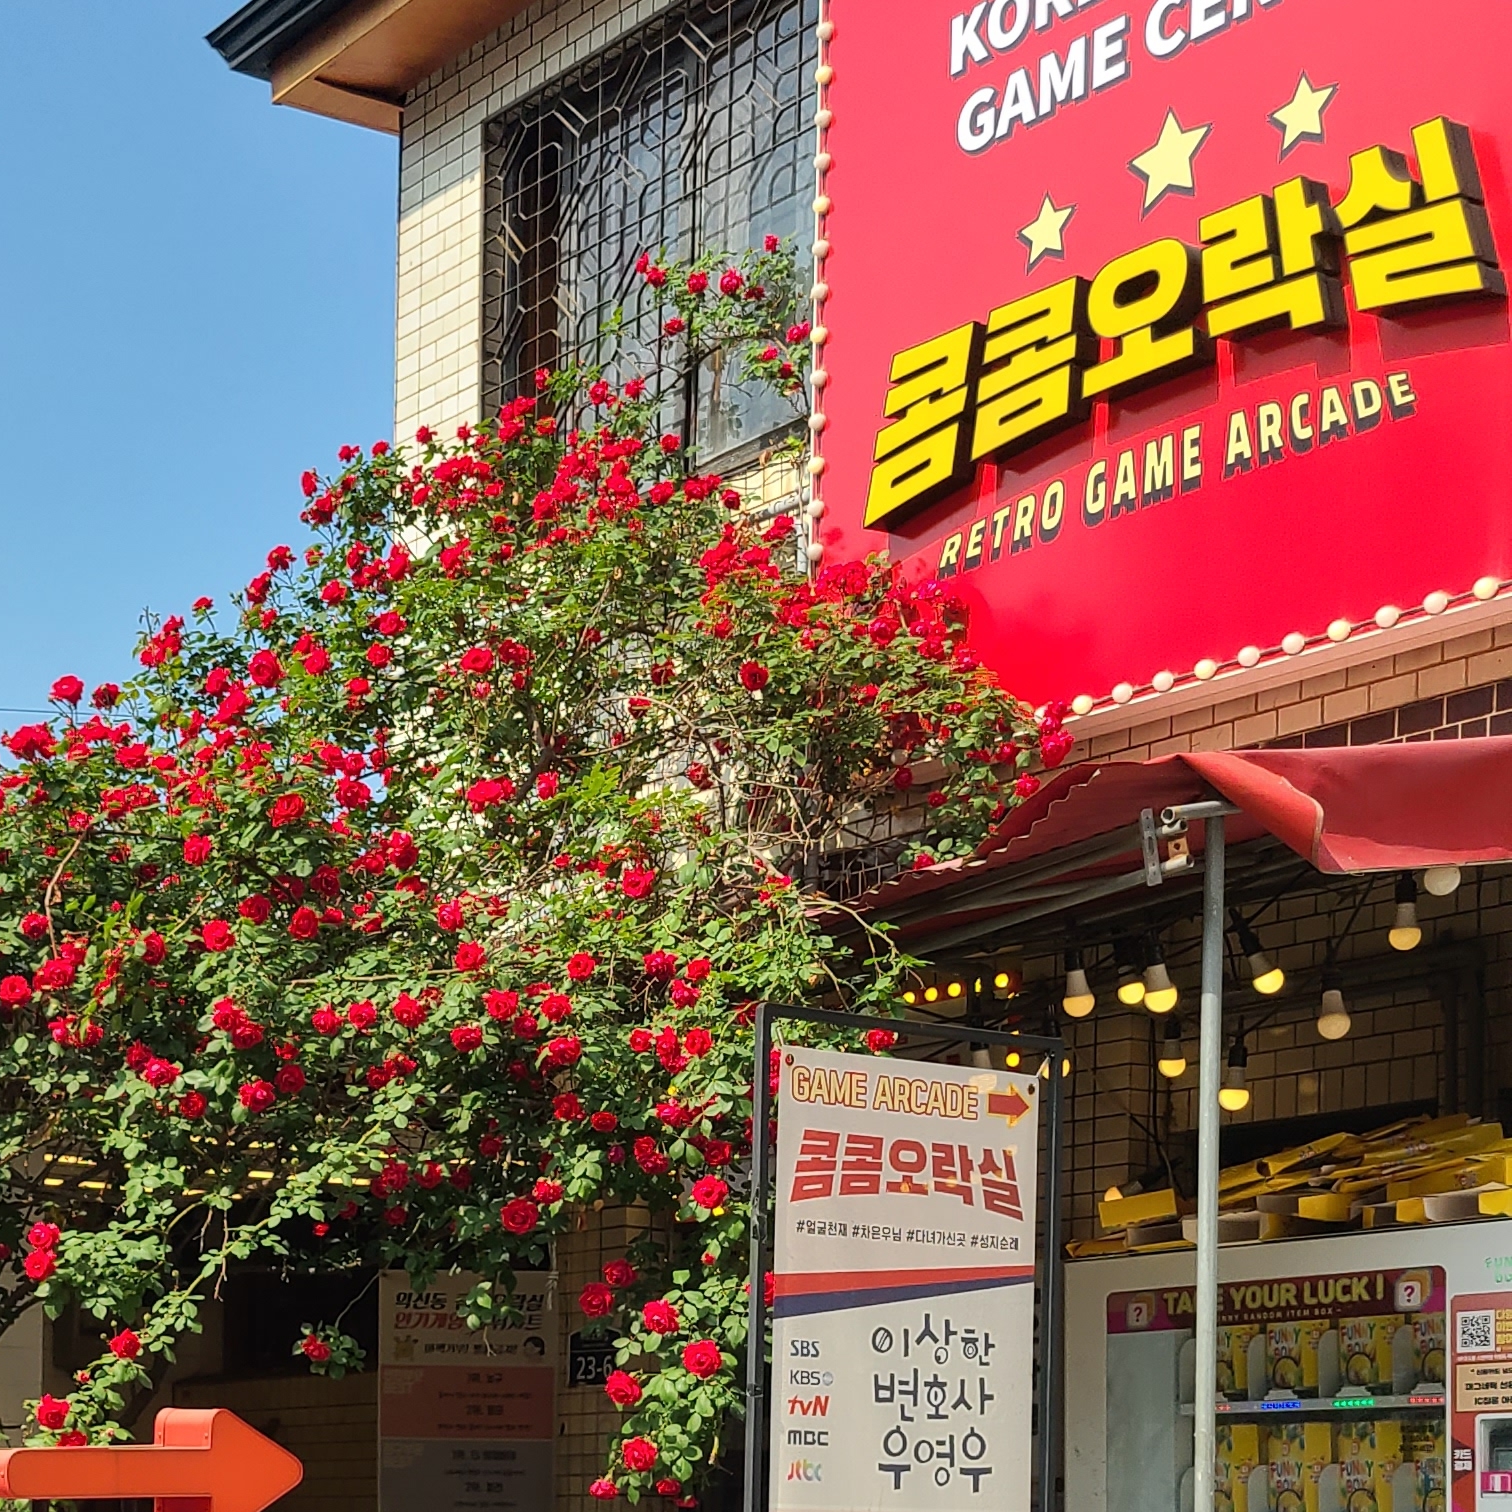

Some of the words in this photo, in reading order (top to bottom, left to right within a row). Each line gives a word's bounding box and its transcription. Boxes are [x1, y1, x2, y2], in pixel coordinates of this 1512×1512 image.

[949, 0, 1096, 77] KO
[956, 13, 1132, 154] GAME
[863, 115, 1496, 530] 콤콤오락실
[938, 480, 1066, 578] RETRO
[1085, 427, 1204, 521] GAME
[1225, 370, 1418, 475] ARCADE
[791, 1065, 868, 1110] GAME
[873, 1075, 979, 1121] ARCADE
[789, 1128, 1025, 1222] 콤콤오락실
[795, 1219, 848, 1237] #얼굴천재
[851, 1224, 902, 1242] #차은우님
[906, 1228, 966, 1248] #다녀가신곳
[970, 1234, 1020, 1251] #성지순례
[1164, 1286, 1224, 1316] TAE
[1230, 1282, 1298, 1311] YOUR
[1314, 1307, 1333, 1316] BOX
[576, 1354, 613, 1380] 23-6
[790, 1339, 820, 1358] SBS
[871, 1313, 996, 1367] 이상한
[789, 1369, 821, 1386] KBS
[873, 1368, 995, 1422] 변호사
[787, 1394, 830, 1417] tvN
[787, 1429, 830, 1446] MBC
[878, 1425, 993, 1493] 우영우
